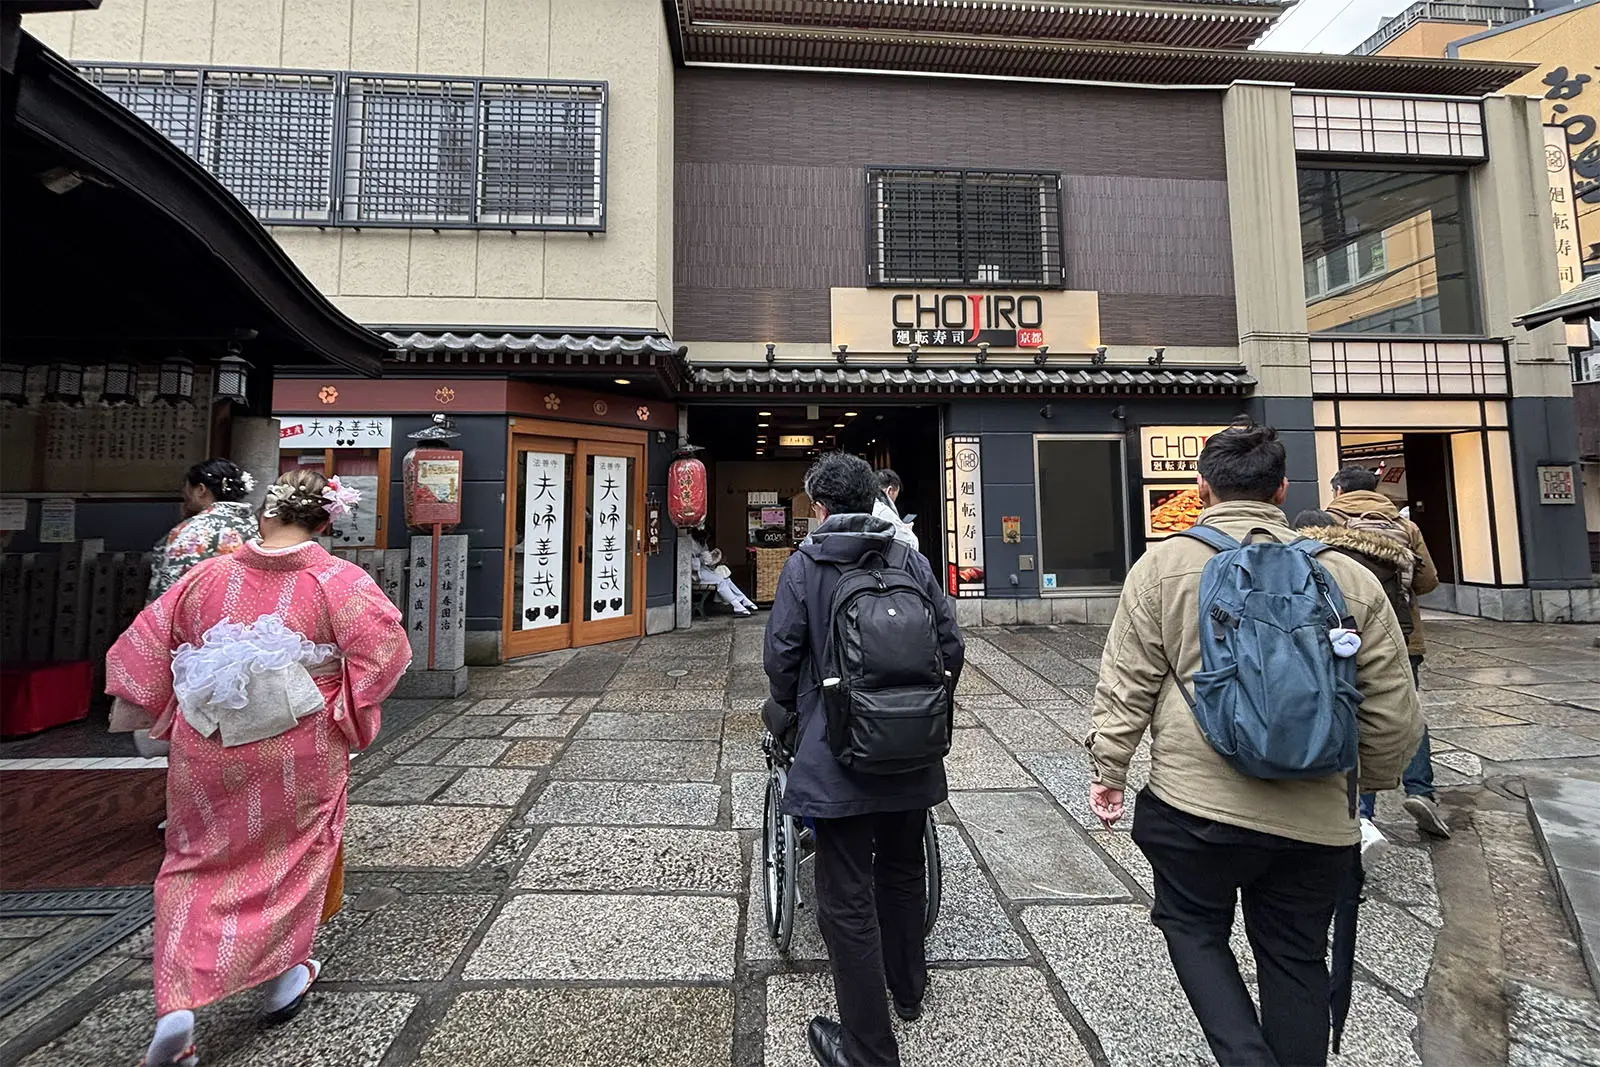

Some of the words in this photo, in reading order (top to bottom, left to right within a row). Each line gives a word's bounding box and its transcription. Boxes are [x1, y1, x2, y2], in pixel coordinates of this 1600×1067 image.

[892, 294, 1043, 342] CHOJIRO
[896, 330, 965, 344] 廻転寿司
[1020, 331, 1042, 344] 京都
[959, 453, 976, 461] CHO
[1543, 471, 1565, 482] CHO
[960, 482, 977, 561] 廻転寿司
